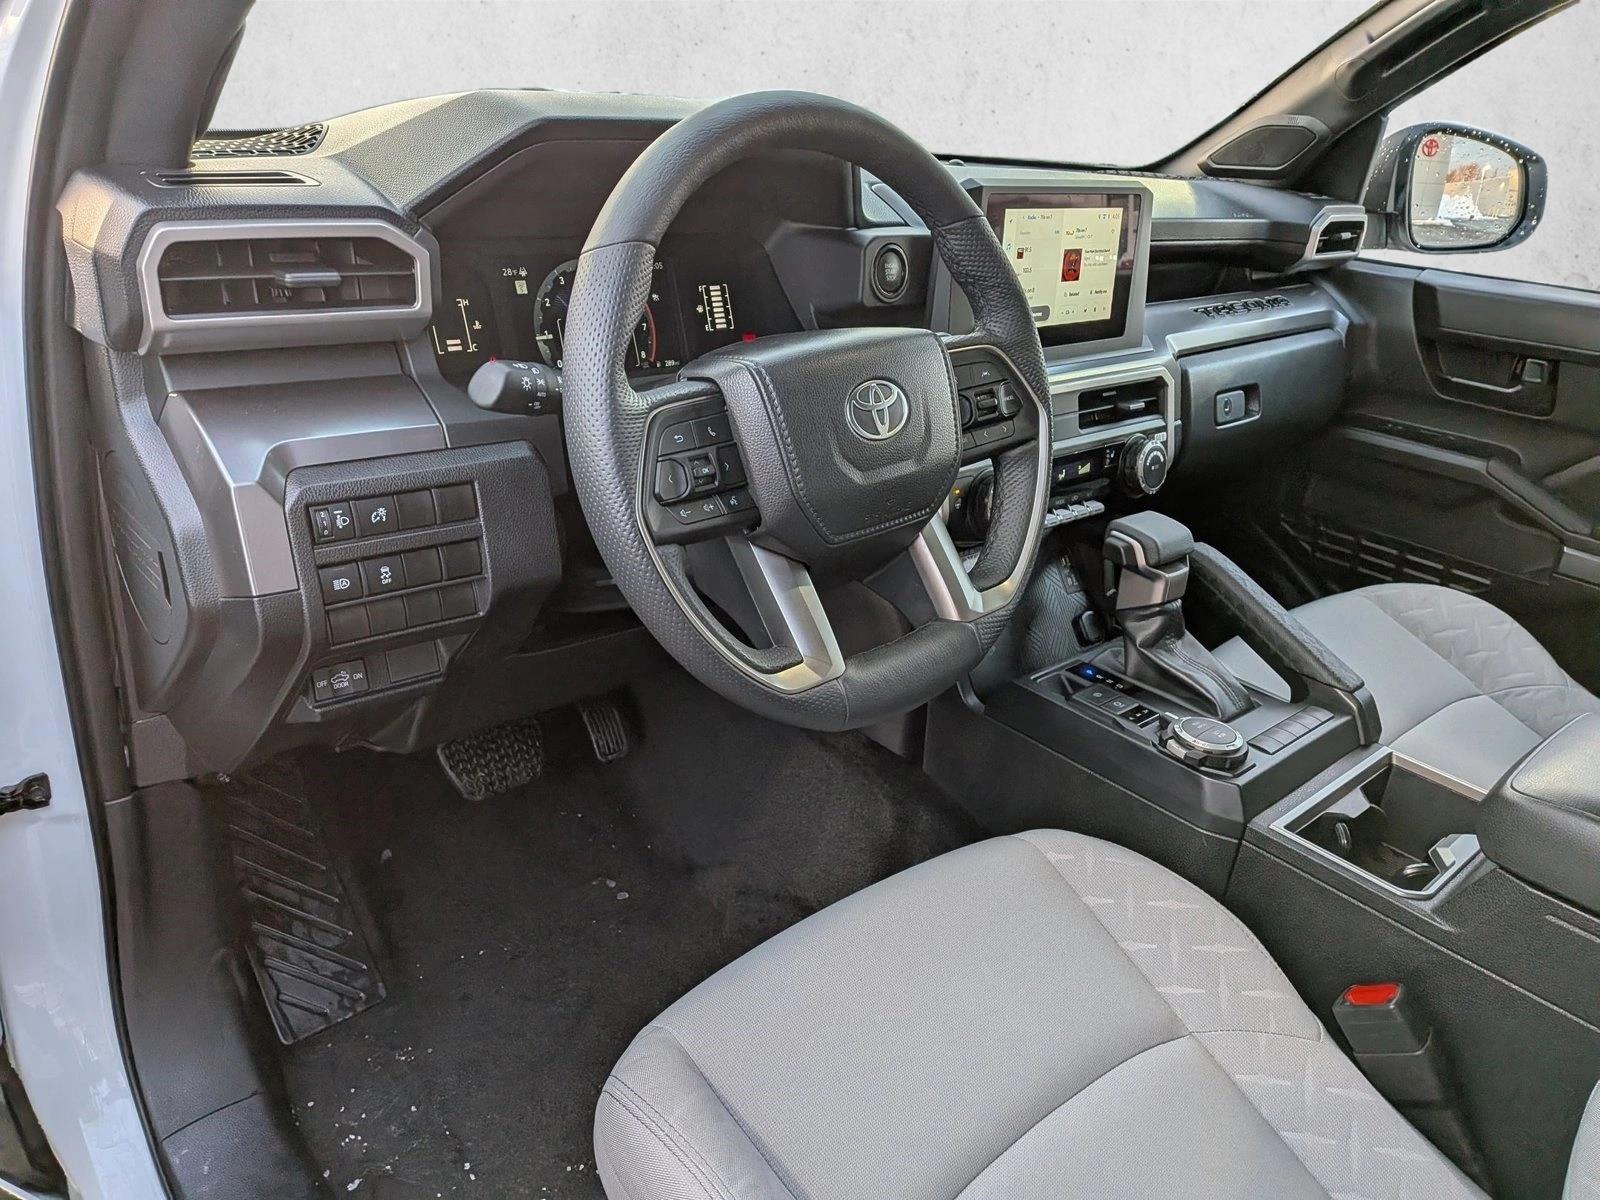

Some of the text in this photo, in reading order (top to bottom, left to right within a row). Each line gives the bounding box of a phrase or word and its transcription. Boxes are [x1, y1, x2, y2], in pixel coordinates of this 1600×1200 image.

[559, 276, 565, 285] 3
[544, 298, 551, 307] 2
[1189, 295, 1293, 319] TACOMA
[641, 322, 647, 331] 7
[472, 343, 479, 351] C
[640, 350, 647, 359] 8
[556, 359, 563, 368] 0
[316, 672, 364, 688] OFF ON
